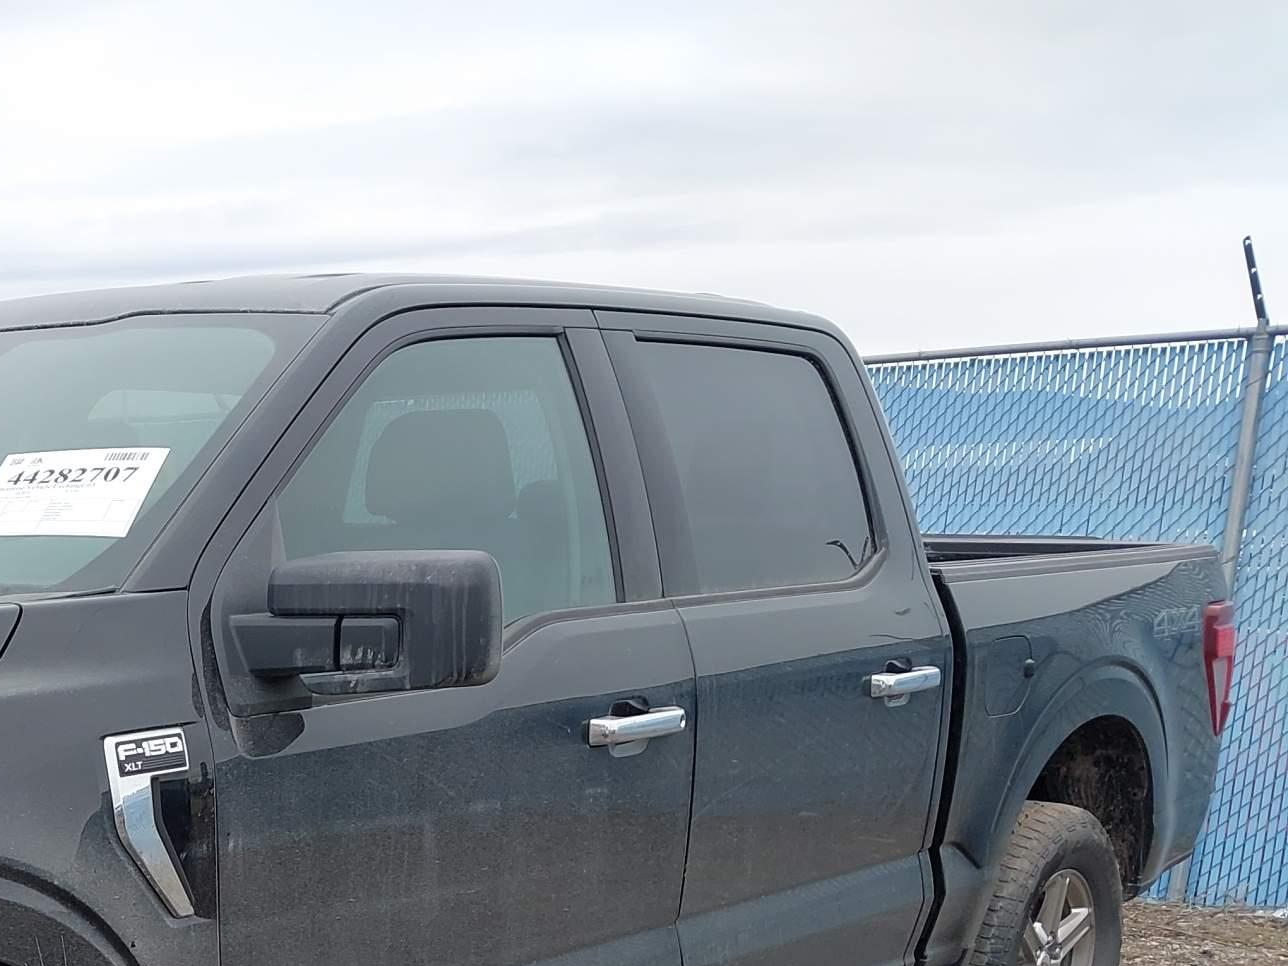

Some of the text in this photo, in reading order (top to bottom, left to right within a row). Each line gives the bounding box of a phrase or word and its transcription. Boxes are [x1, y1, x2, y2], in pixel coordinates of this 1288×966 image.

[8, 466, 140, 486] 44282707
[117, 736, 184, 761] F-150
[124, 761, 143, 772] XLT
